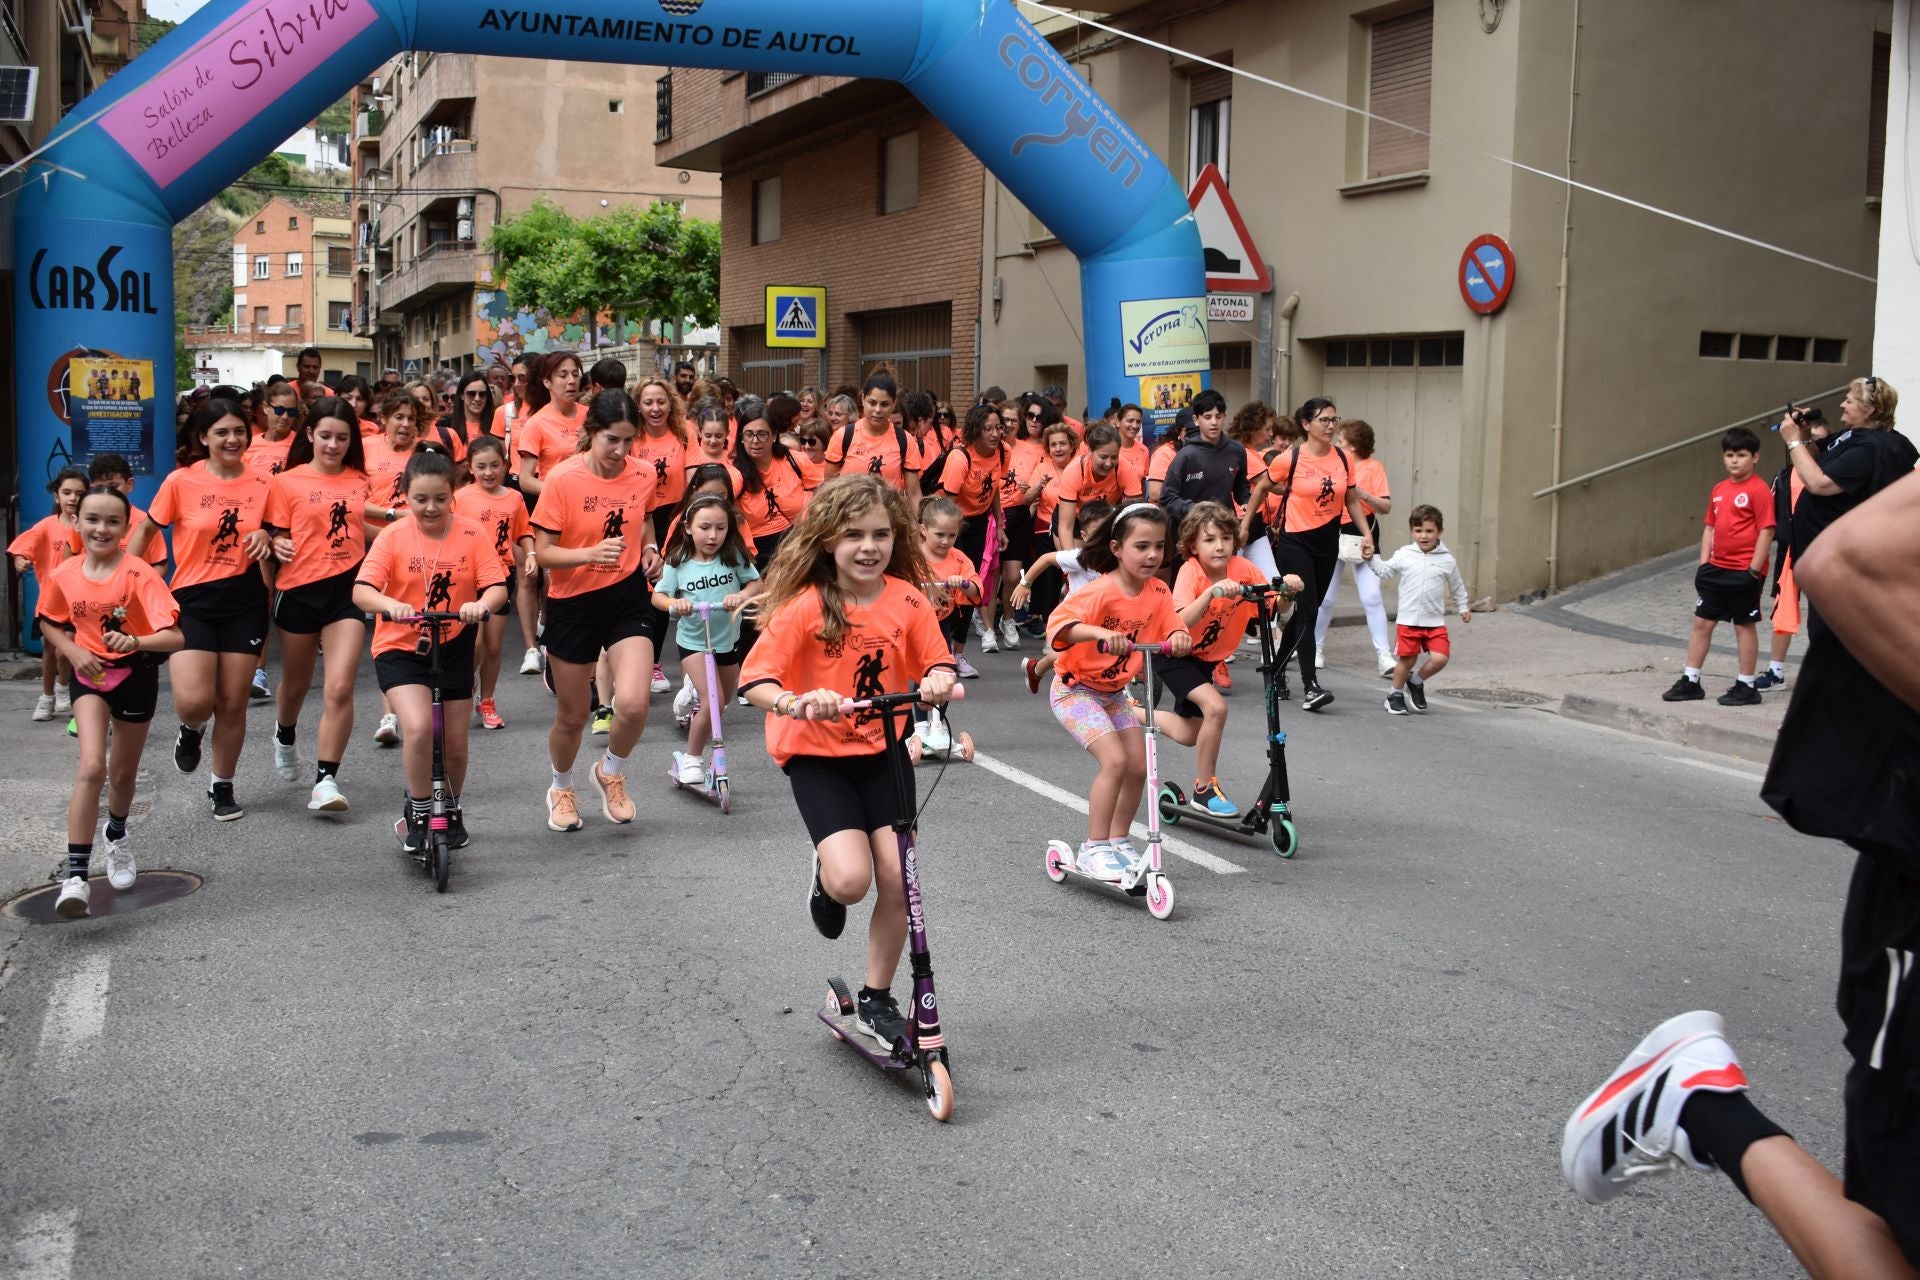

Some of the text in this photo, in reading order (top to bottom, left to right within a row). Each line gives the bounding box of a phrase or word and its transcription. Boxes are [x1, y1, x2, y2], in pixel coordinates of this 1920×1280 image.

[229, 0, 349, 90] Silvia
[479, 8, 861, 56] AYUNTAMIENTO DE AUTOL
[143, 65, 215, 129] Salón de
[147, 106, 215, 160] Belleza
[1129, 309, 1181, 354] Verona
[686, 572, 734, 591] adidas
